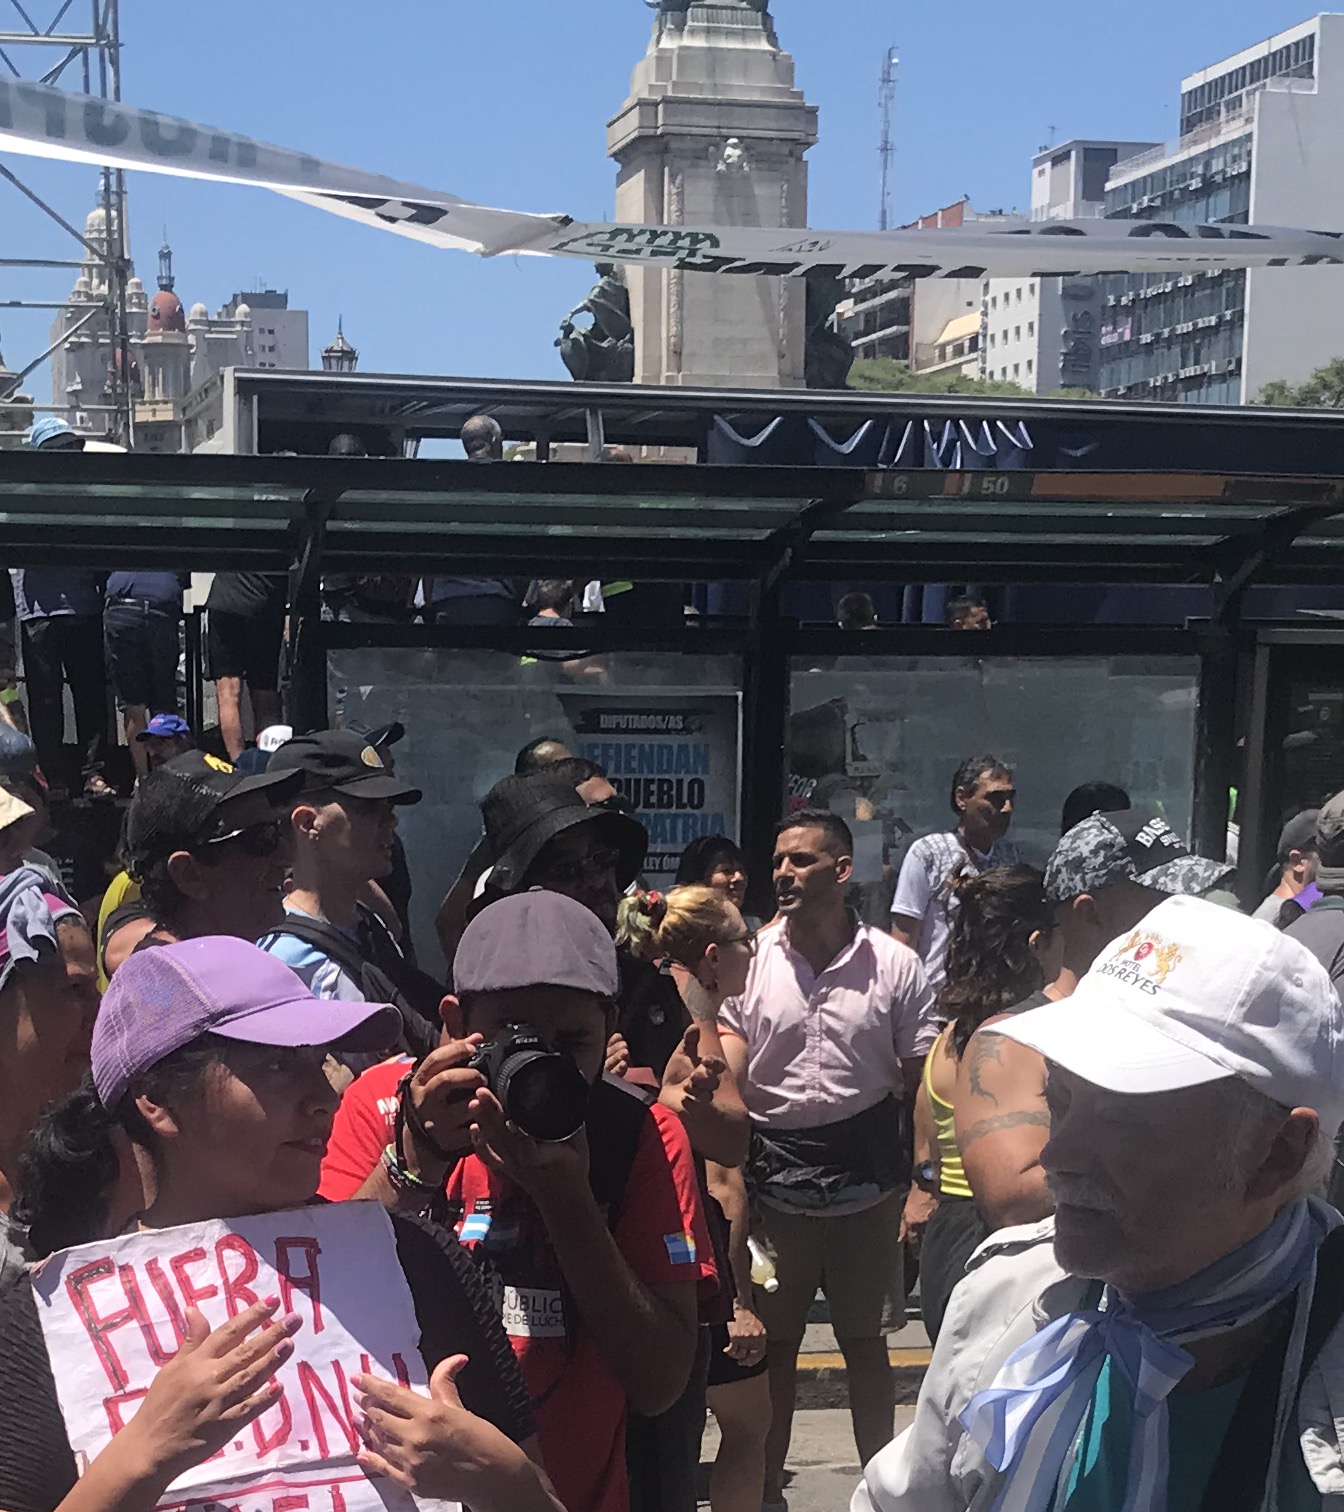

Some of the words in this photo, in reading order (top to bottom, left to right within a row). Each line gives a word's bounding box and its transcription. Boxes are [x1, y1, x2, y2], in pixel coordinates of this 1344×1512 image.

[980, 476, 1009, 495] 50
[600, 714, 684, 730] DIPUTADOS/AS
[1113, 967, 1162, 996] REYES
[65, 1232, 323, 1393] FUERA
